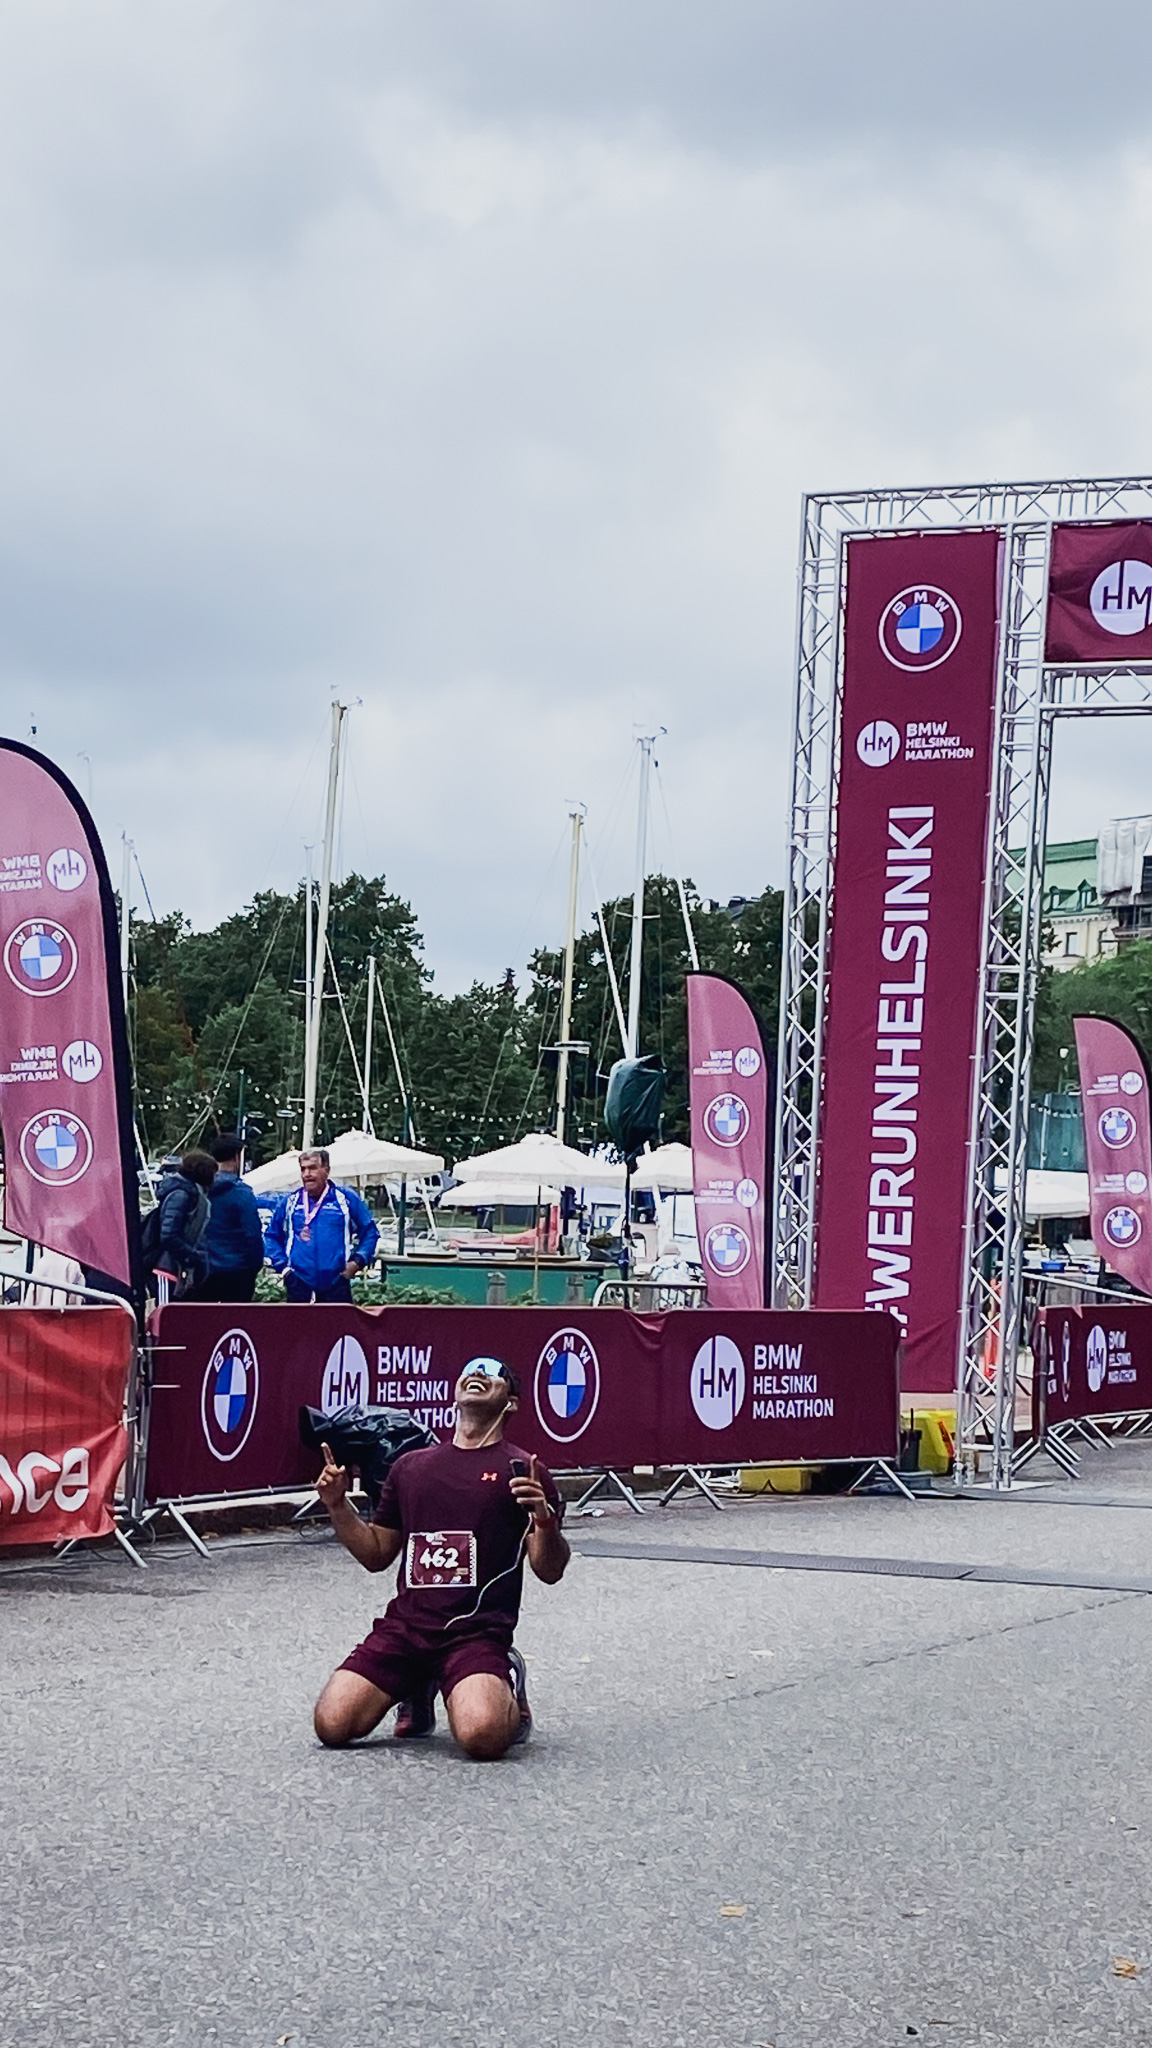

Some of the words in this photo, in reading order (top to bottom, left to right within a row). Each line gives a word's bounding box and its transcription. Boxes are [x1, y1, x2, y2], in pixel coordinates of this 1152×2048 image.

[892, 591, 950, 616] BMW
[906, 721, 948, 737] BMW
[905, 737, 960, 749] HELSINKI
[905, 748, 974, 761] MARATHON
[213, 1337, 253, 1373] BMW
[377, 1345, 433, 1375] BMW
[545, 1335, 591, 1366] BMW
[754, 1343, 803, 1370] BMW
[376, 1380, 449, 1402] HELSINKI
[753, 1374, 817, 1395] HELSINKI
[752, 1398, 834, 1420] MARATHON
[419, 1547, 460, 1570] 462
